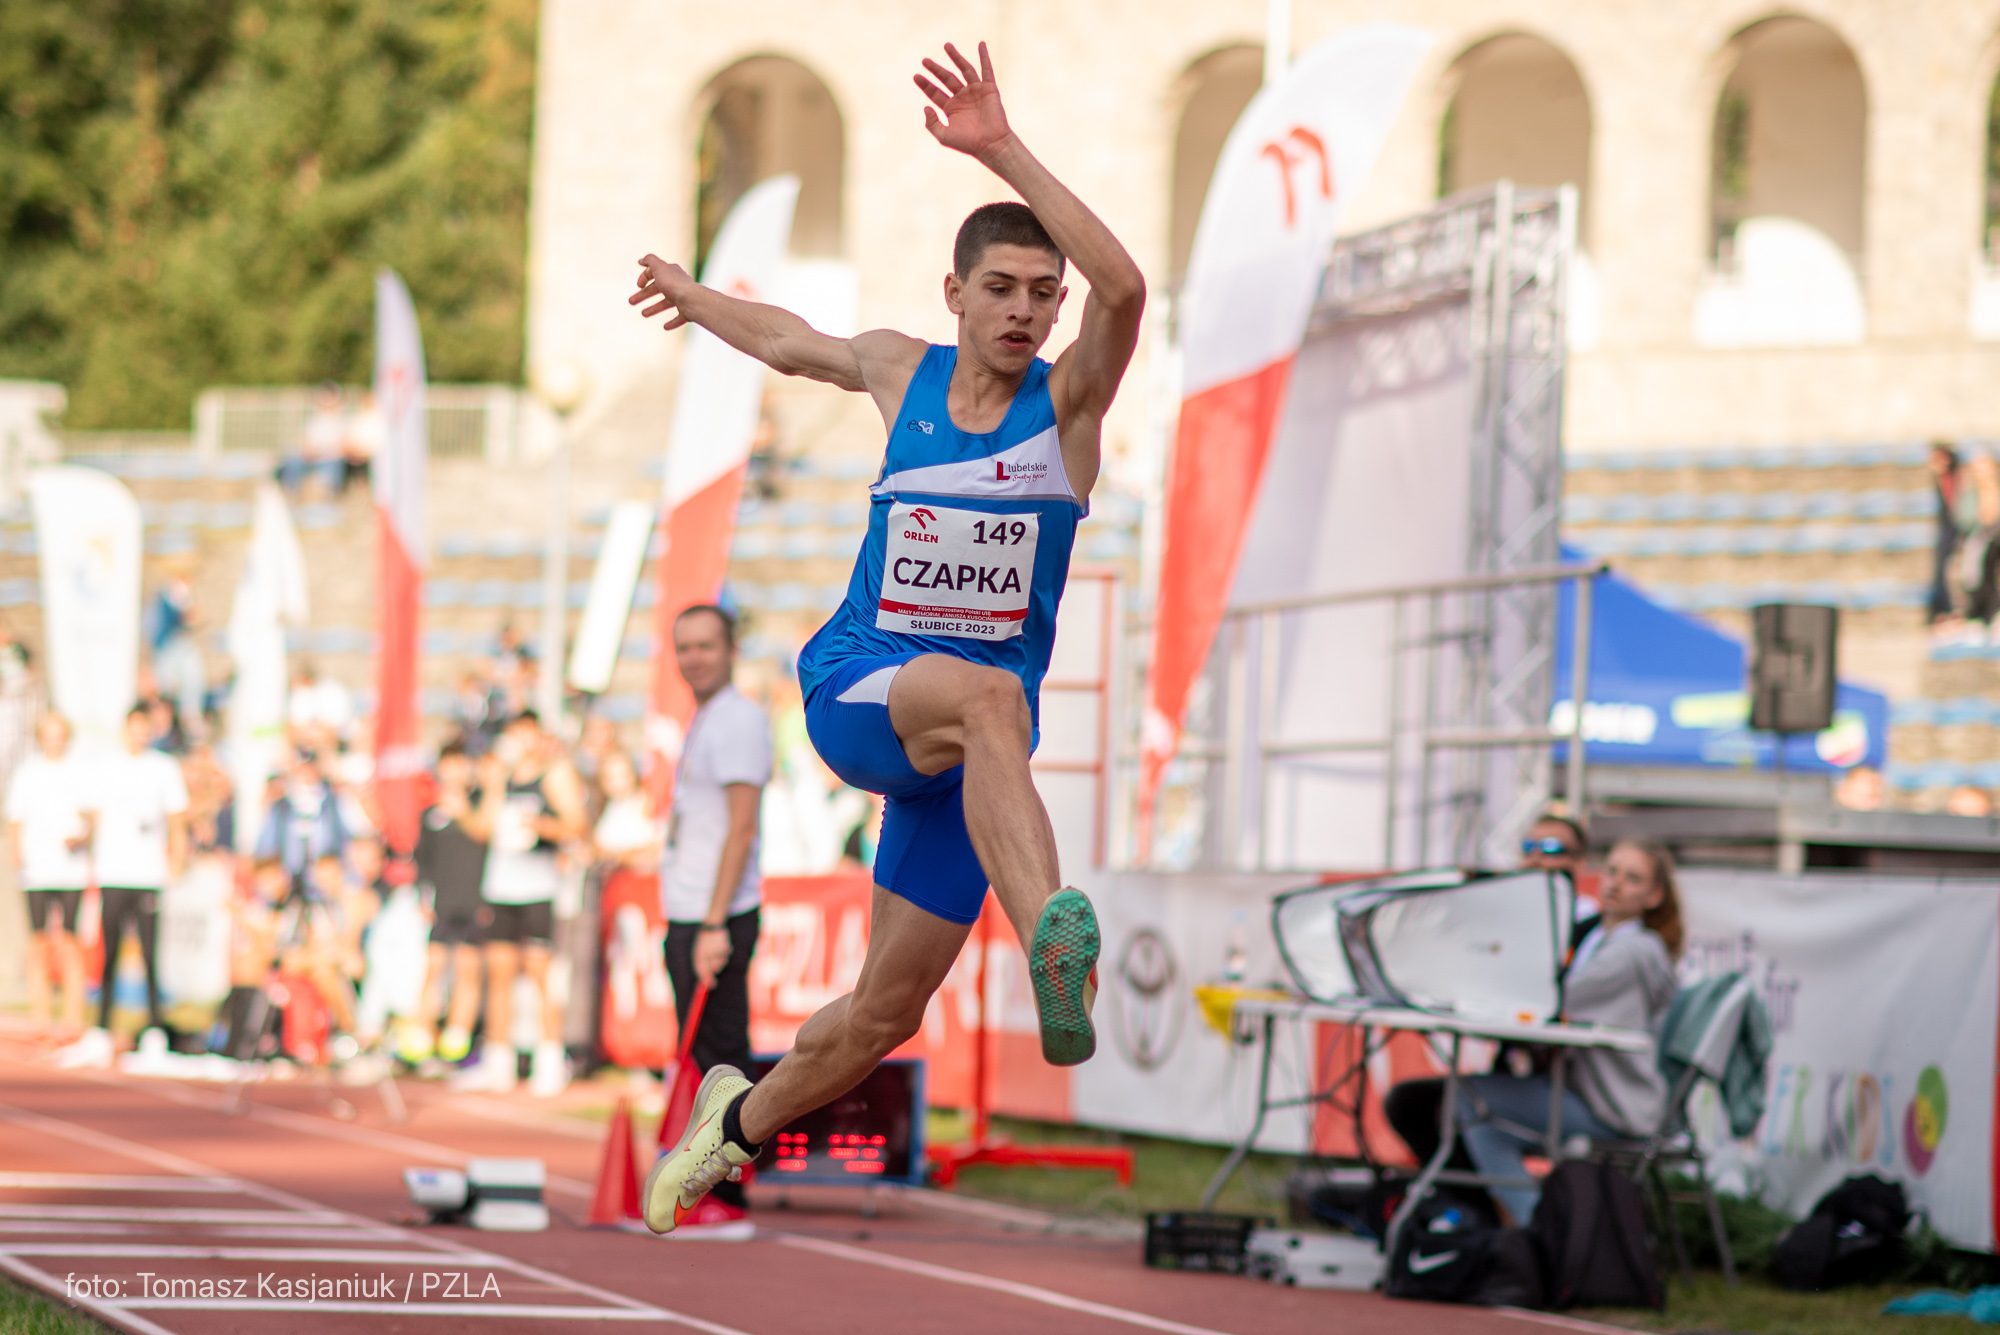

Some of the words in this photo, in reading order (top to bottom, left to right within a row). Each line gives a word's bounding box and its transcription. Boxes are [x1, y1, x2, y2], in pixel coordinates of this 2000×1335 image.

[903, 530, 939, 544] ORLEN
[972, 519, 1026, 546] 149
[893, 557, 1022, 594] CZAPKA
[910, 619, 962, 632] SŁUBICE
[965, 623, 995, 635] 2023
